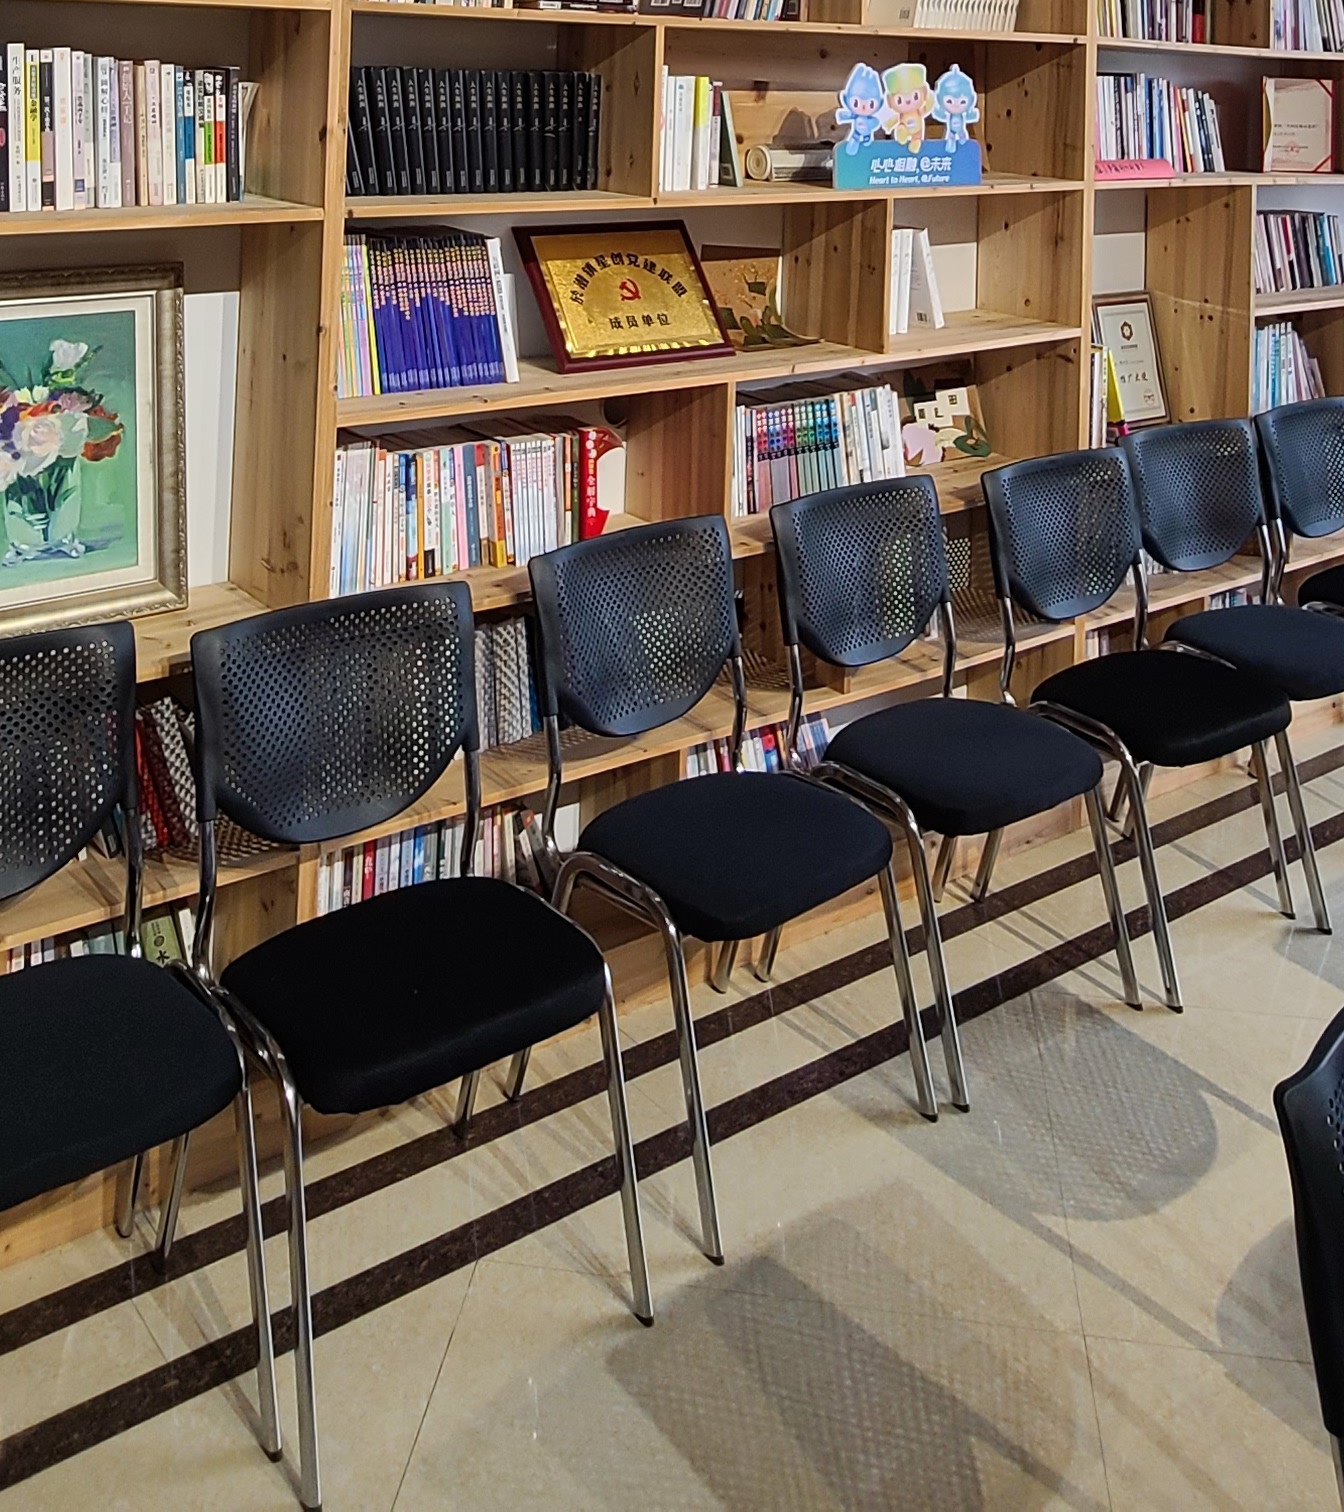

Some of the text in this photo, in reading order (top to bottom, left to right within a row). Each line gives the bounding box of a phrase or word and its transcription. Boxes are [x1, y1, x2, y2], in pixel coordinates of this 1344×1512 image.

[869, 175, 889, 185] Heart
[890, 176, 898, 184] to
[608, 312, 671, 330] 成员单位
